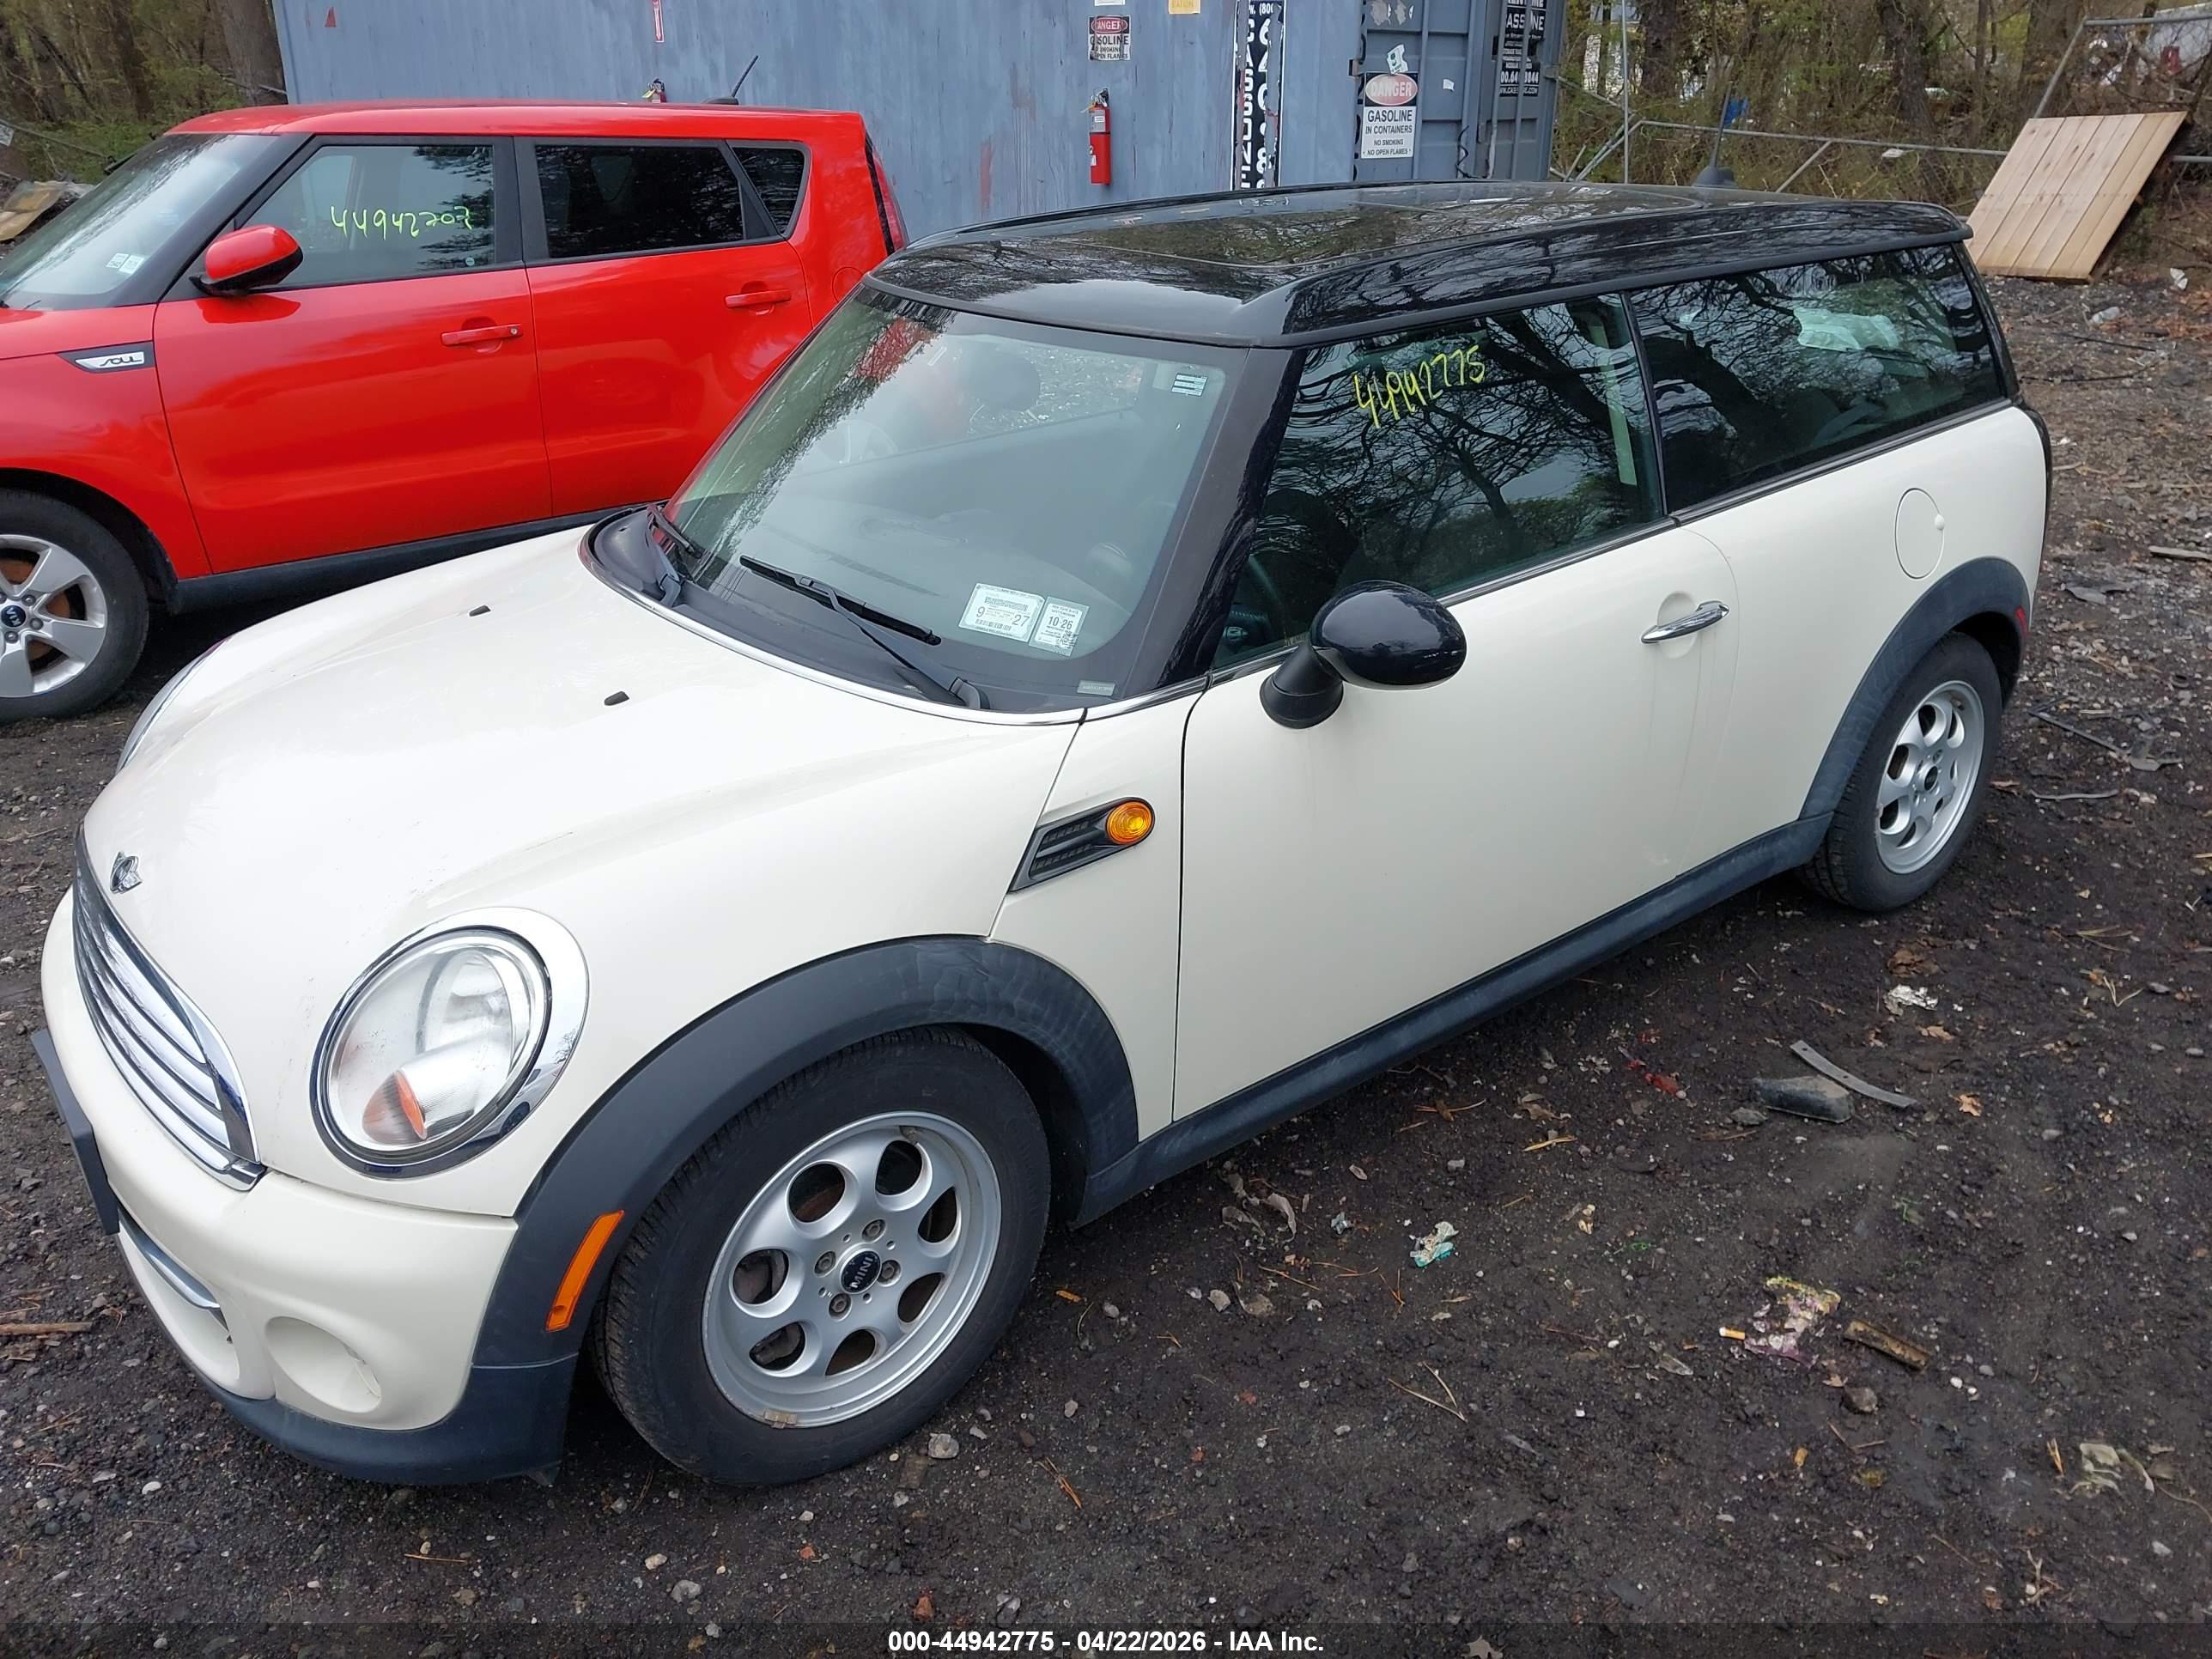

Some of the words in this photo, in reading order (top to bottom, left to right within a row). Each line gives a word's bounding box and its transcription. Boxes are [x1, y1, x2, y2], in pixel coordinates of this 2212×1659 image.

[1505, 12, 1545, 31] ASSNE
[1091, 35, 1129, 45] GSOLINE
[1371, 82, 1413, 96] DANGER
[1367, 110, 1413, 122] GASOLINE
[1374, 125, 1413, 134] CONTAINERS
[1353, 344, 1486, 429] 44942775
[976, 606, 986, 617] 9
[1012, 614, 1030, 627] 27
[850, 1256, 873, 1288] MINI
